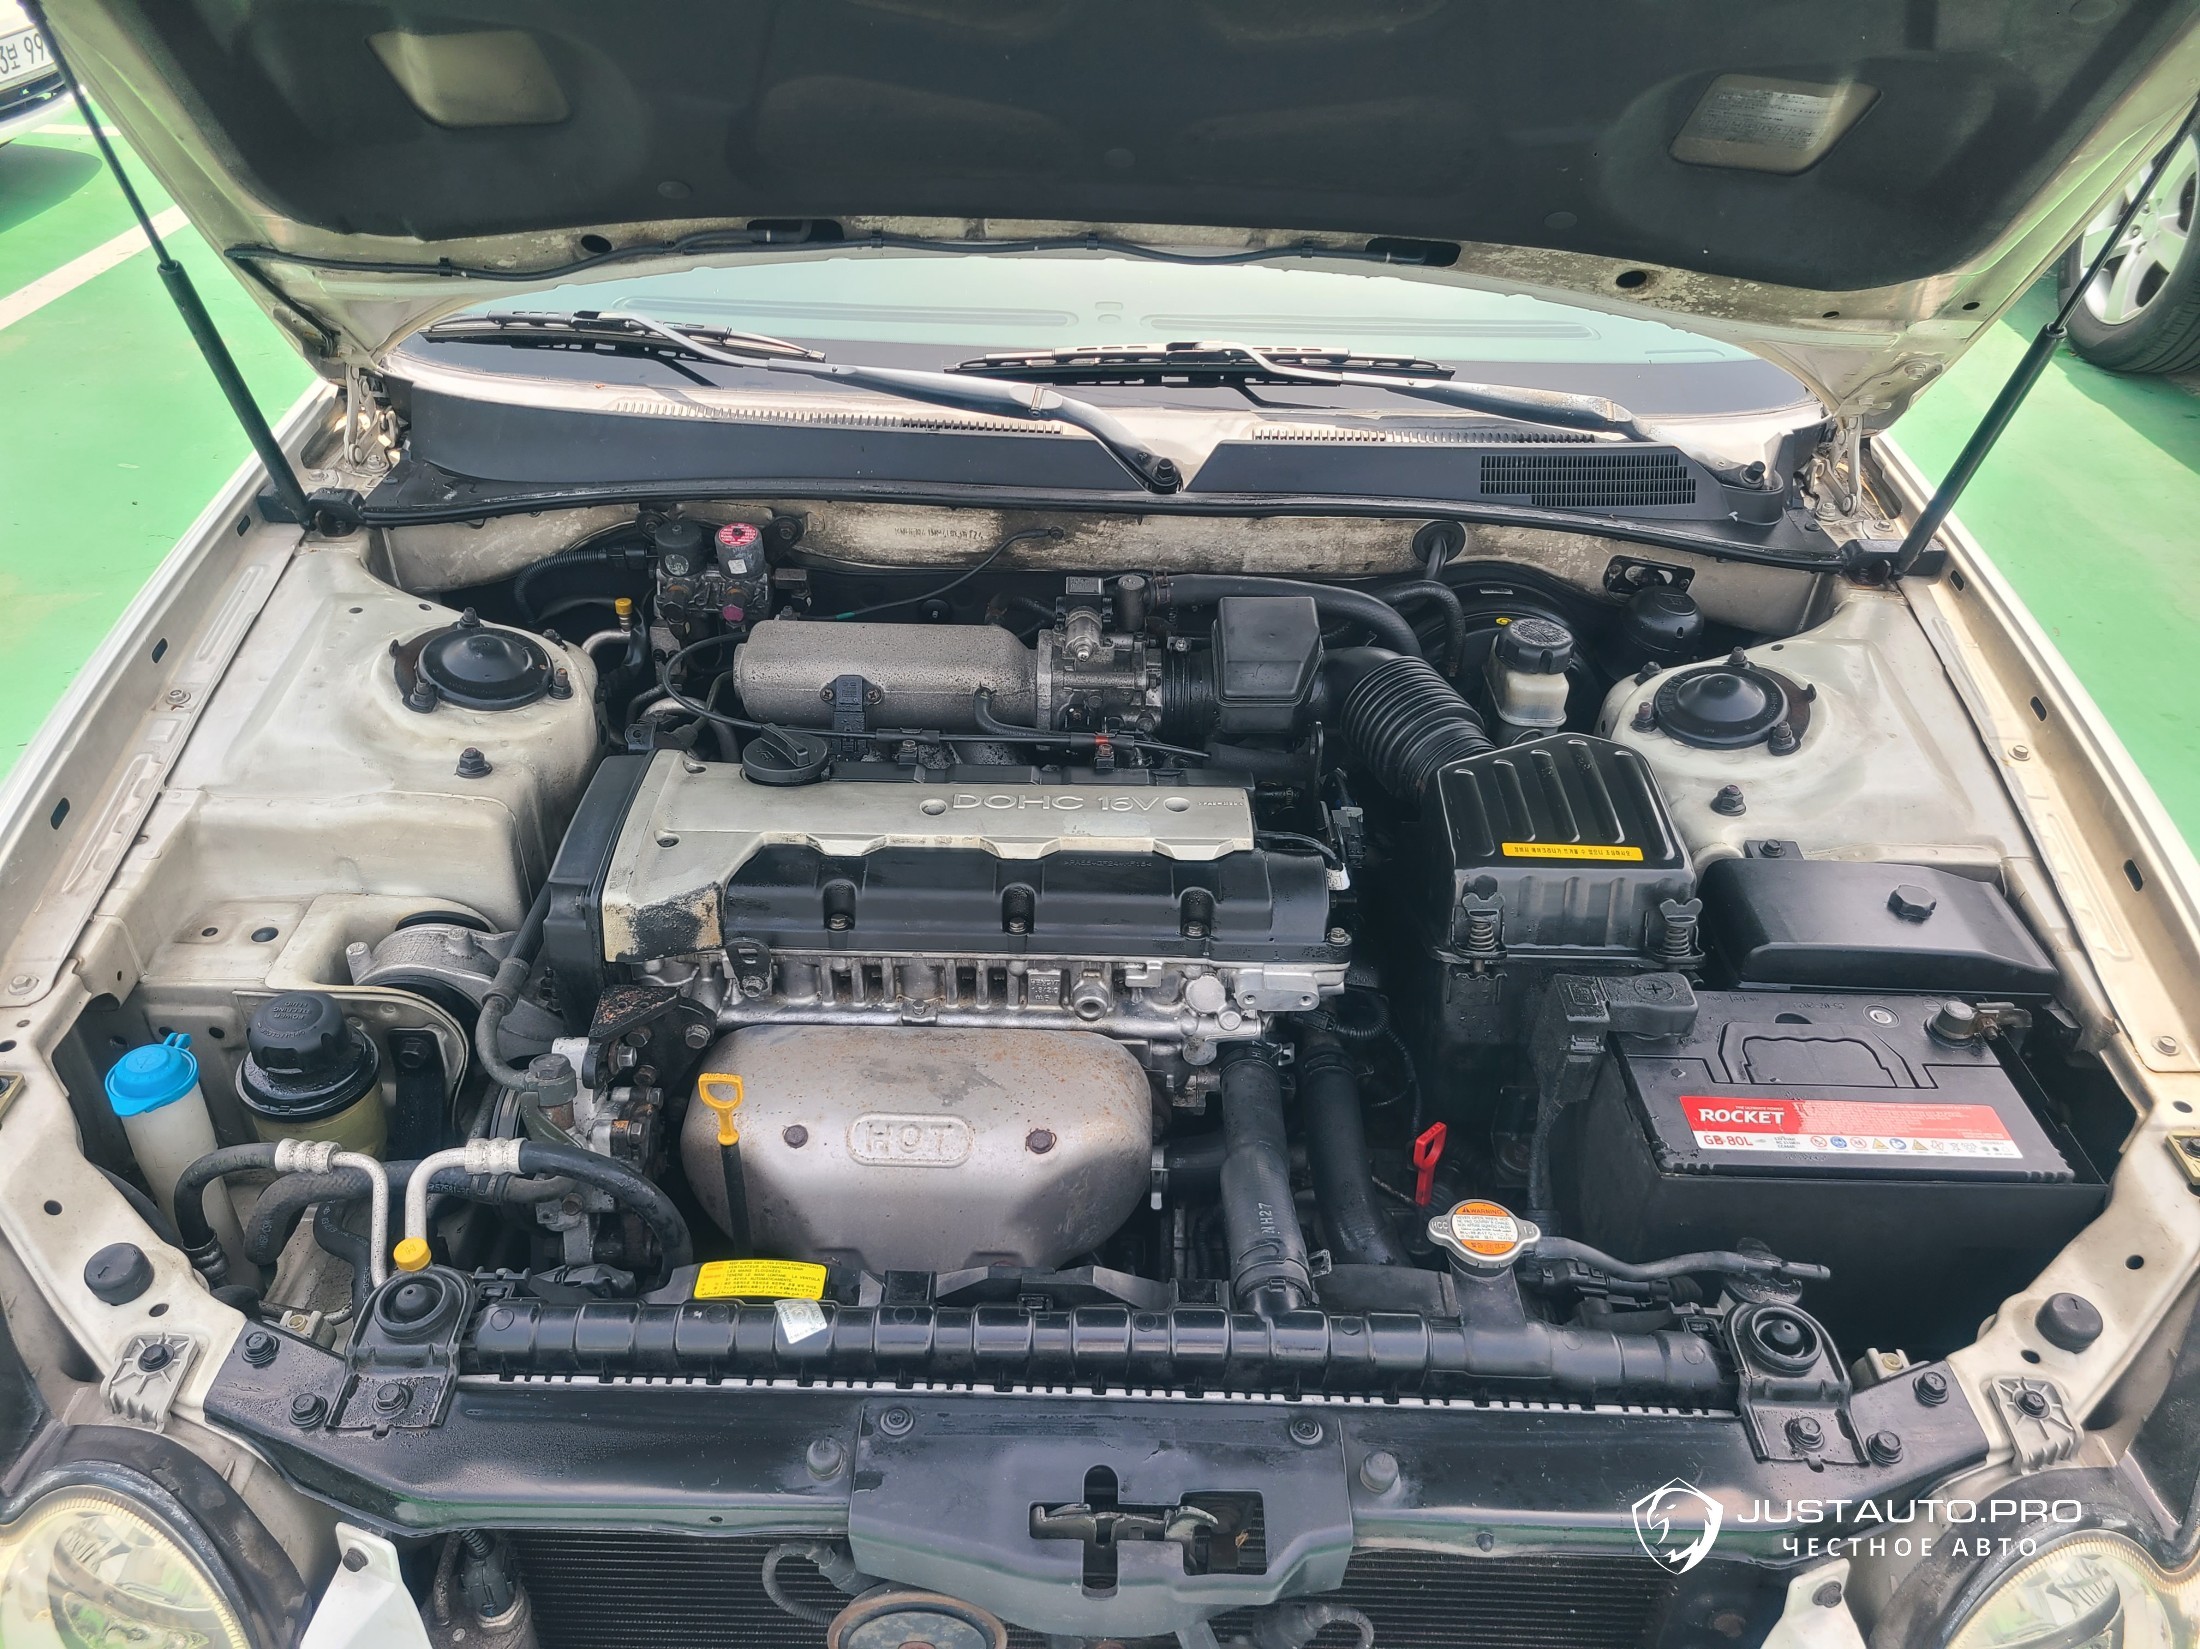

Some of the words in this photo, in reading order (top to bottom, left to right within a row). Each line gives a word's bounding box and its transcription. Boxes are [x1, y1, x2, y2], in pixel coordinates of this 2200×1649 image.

[952, 793, 1084, 810] DOHC
[1098, 795, 1160, 812] 16V
[1698, 1108, 1785, 1124] ROCKET
[865, 1123, 955, 1154] HOT
